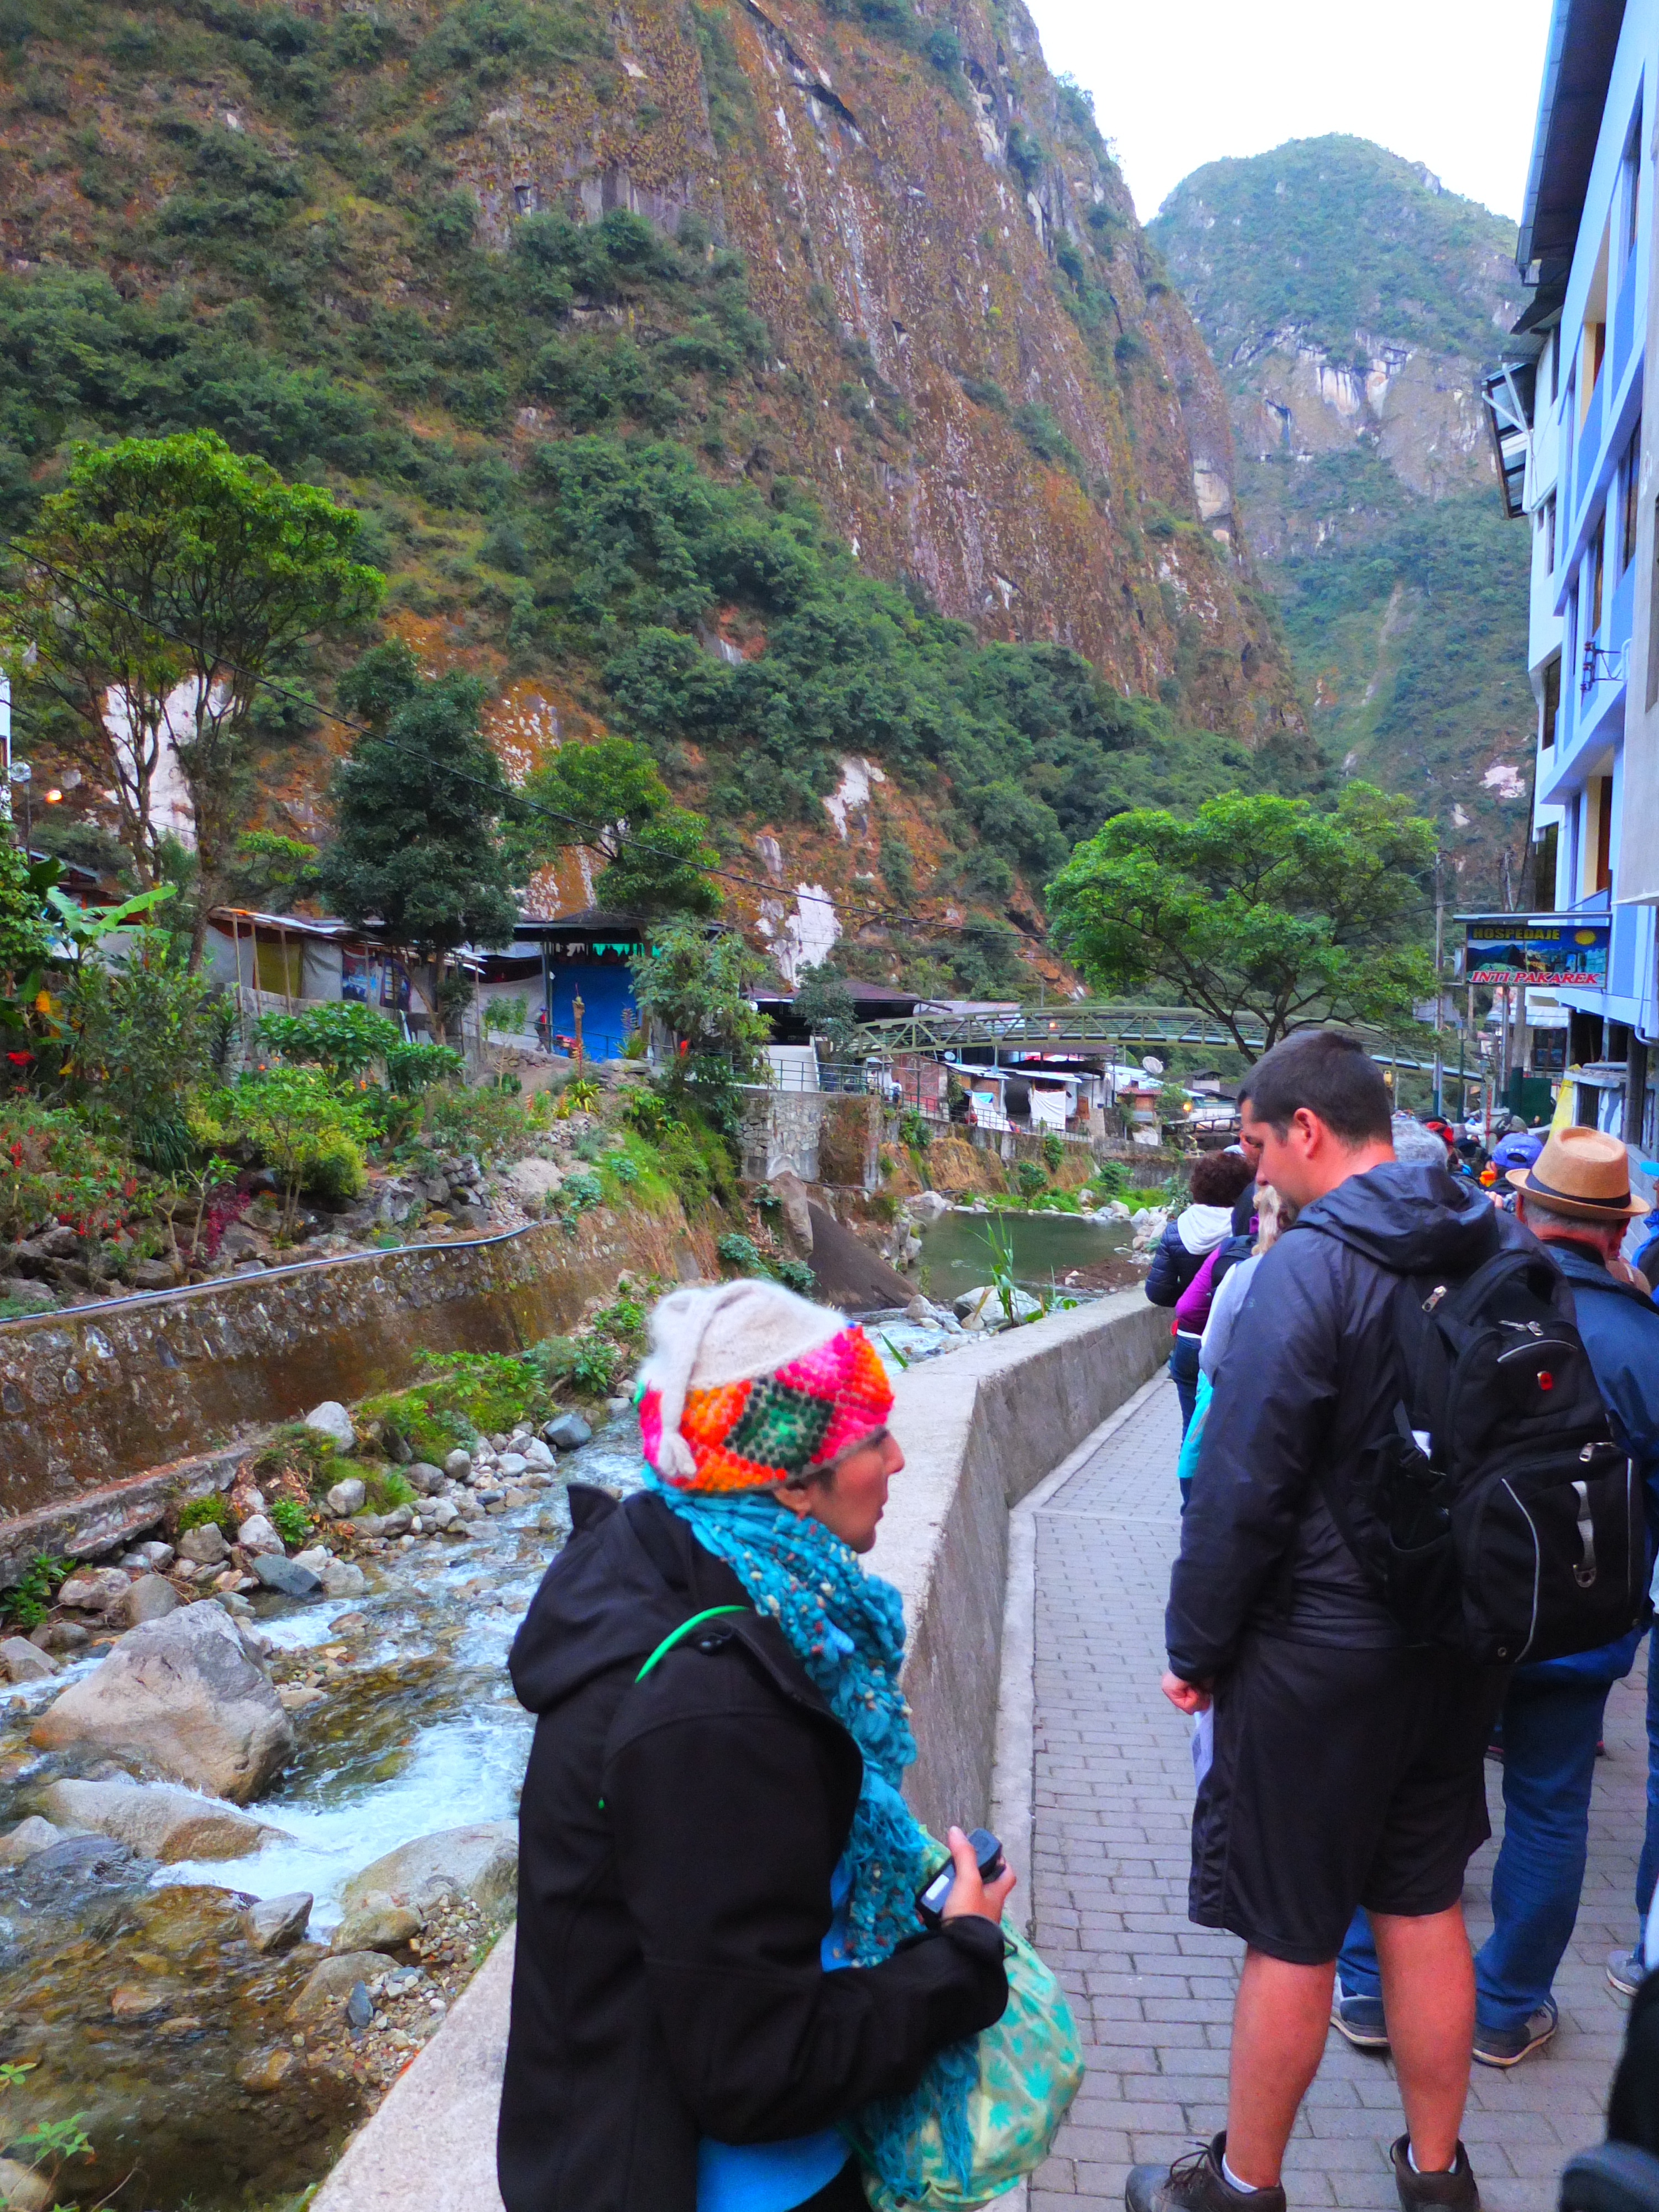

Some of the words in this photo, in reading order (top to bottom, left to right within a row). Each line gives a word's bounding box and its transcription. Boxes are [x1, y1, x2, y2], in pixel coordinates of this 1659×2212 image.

[1473, 927, 1560, 940] HOSPEDAJE
[1470, 971, 1511, 983] INTI
[1512, 971, 1600, 984] PAKAREK
